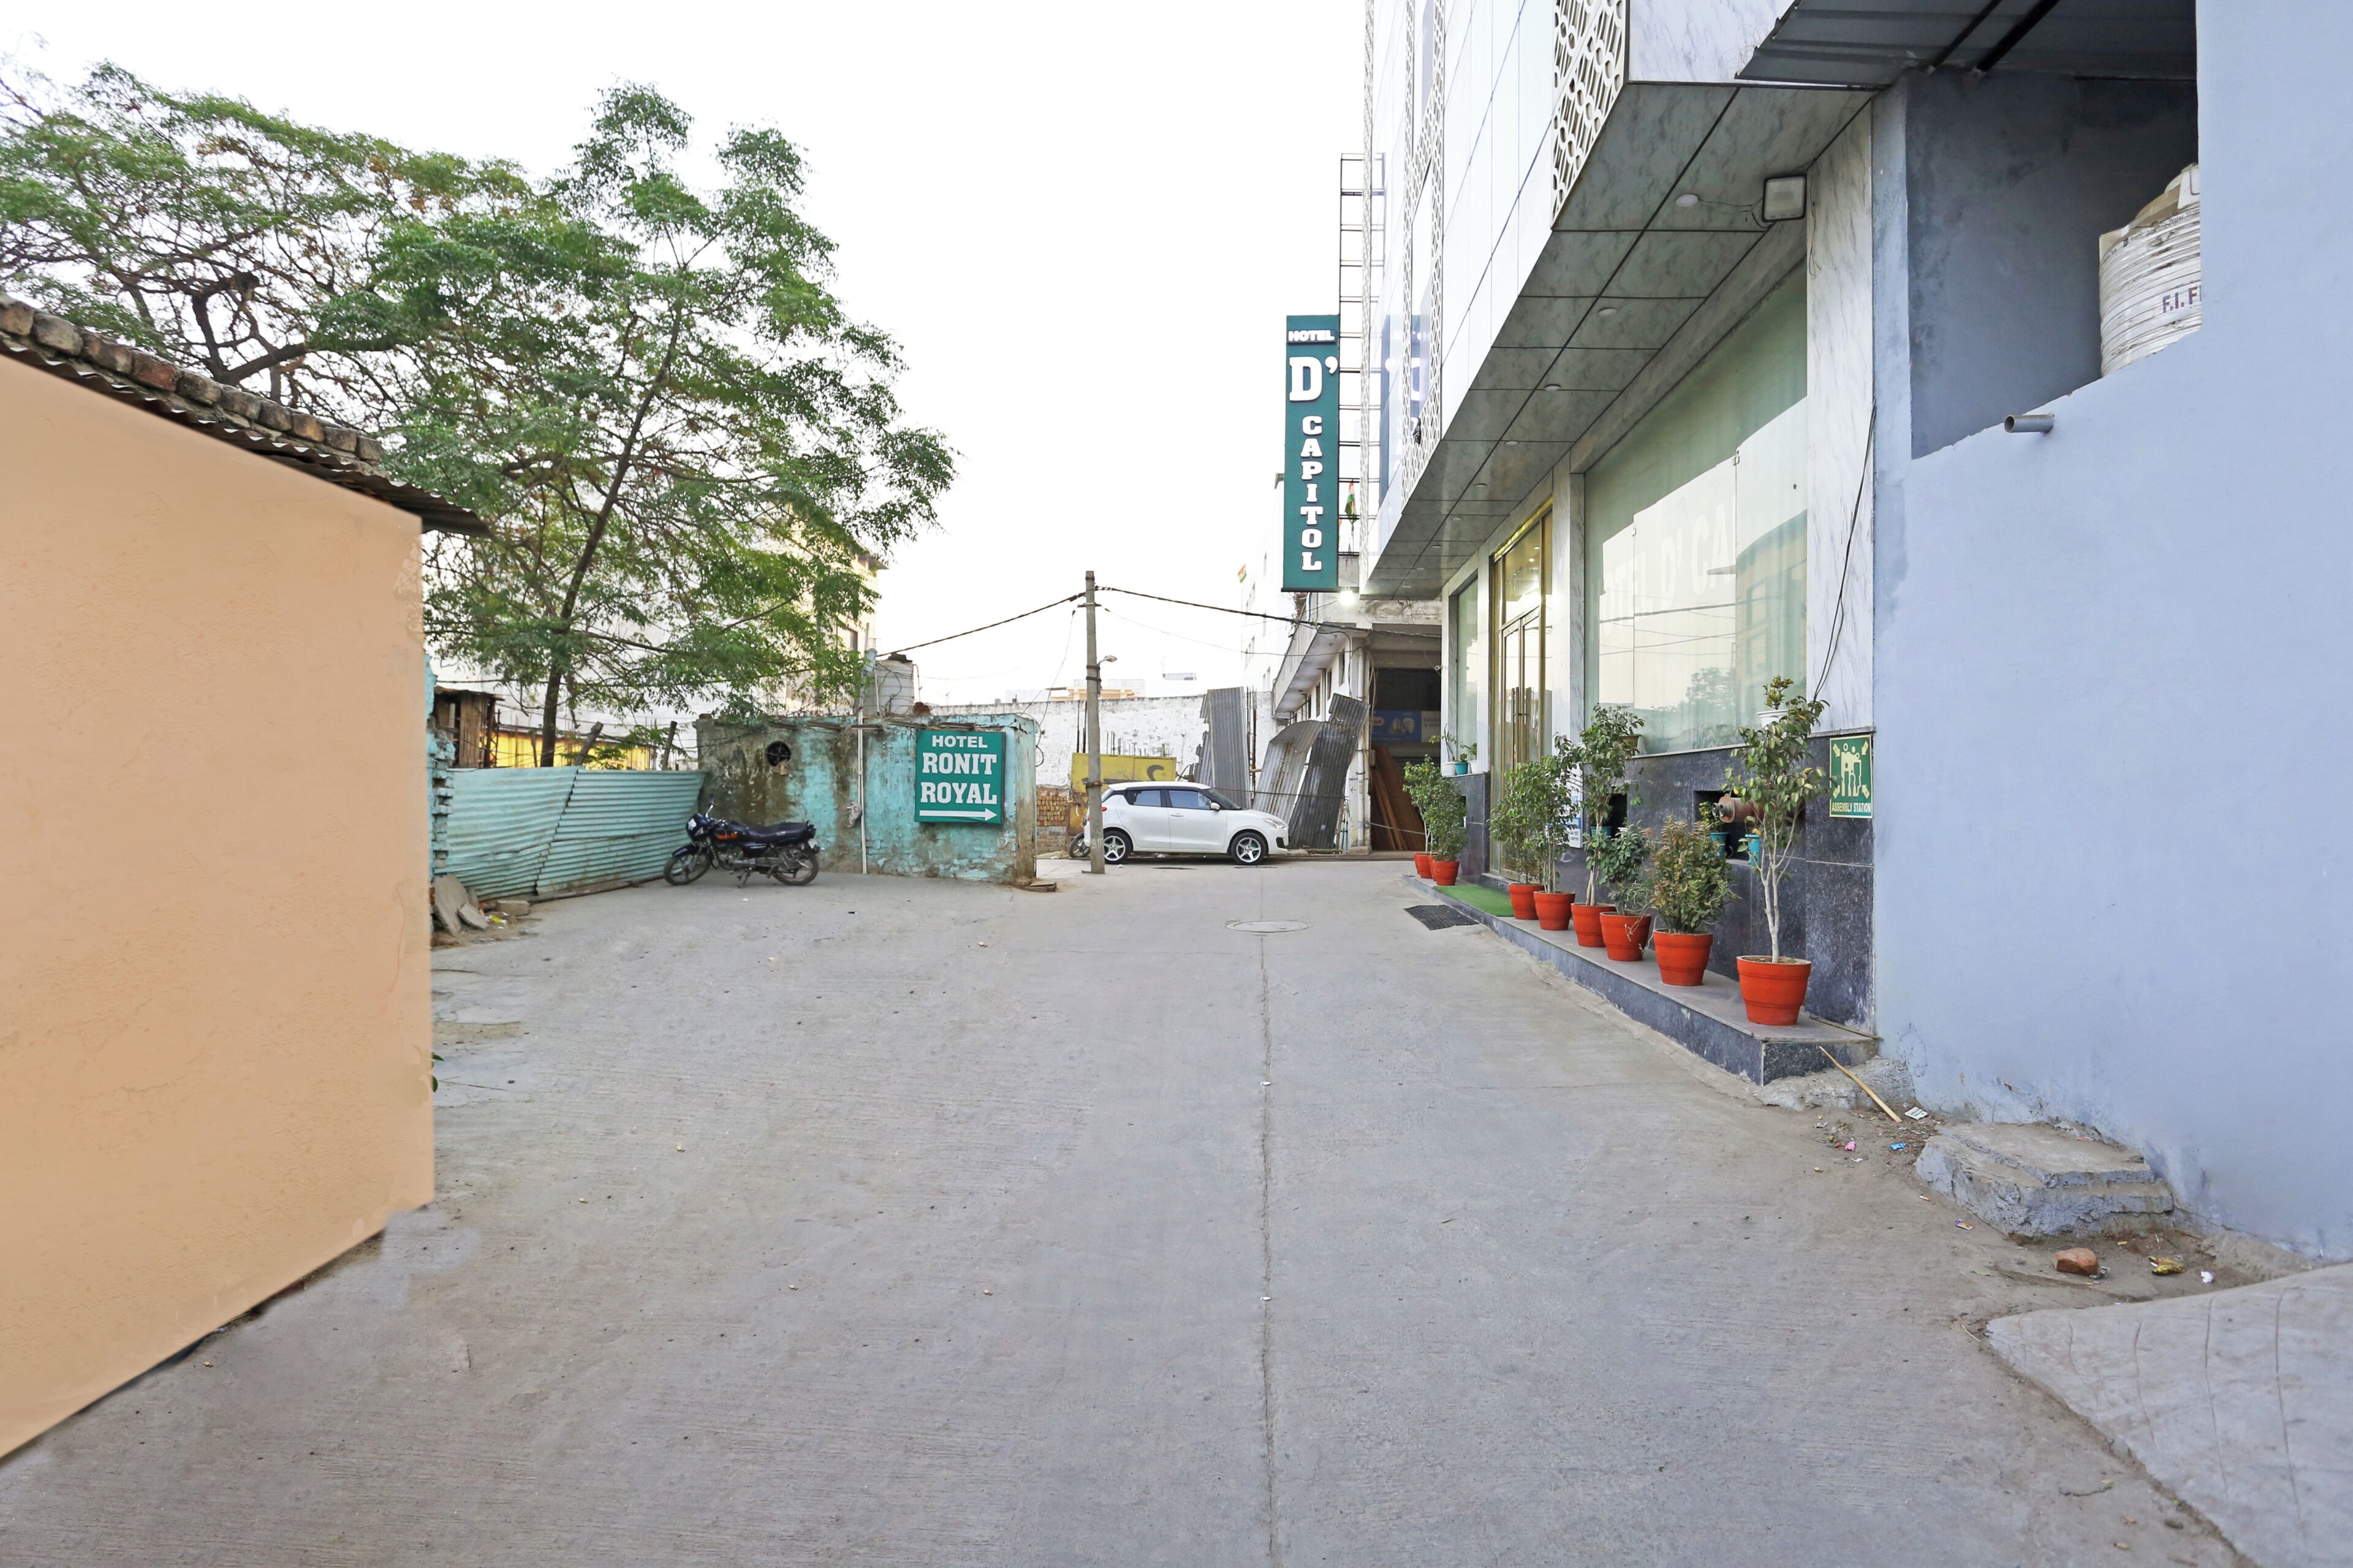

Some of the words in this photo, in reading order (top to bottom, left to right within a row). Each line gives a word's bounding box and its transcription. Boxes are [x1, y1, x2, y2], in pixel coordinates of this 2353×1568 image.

[1288, 330, 1335, 342] HOTEL
[1300, 415, 1324, 571] CAPITOL
[931, 735, 988, 748] HOTEL
[922, 752, 998, 775] RONIT
[920, 781, 998, 805] ROYAL
[1832, 802, 1853, 812] ASSEMBLY
[1853, 802, 1871, 813] STATION
